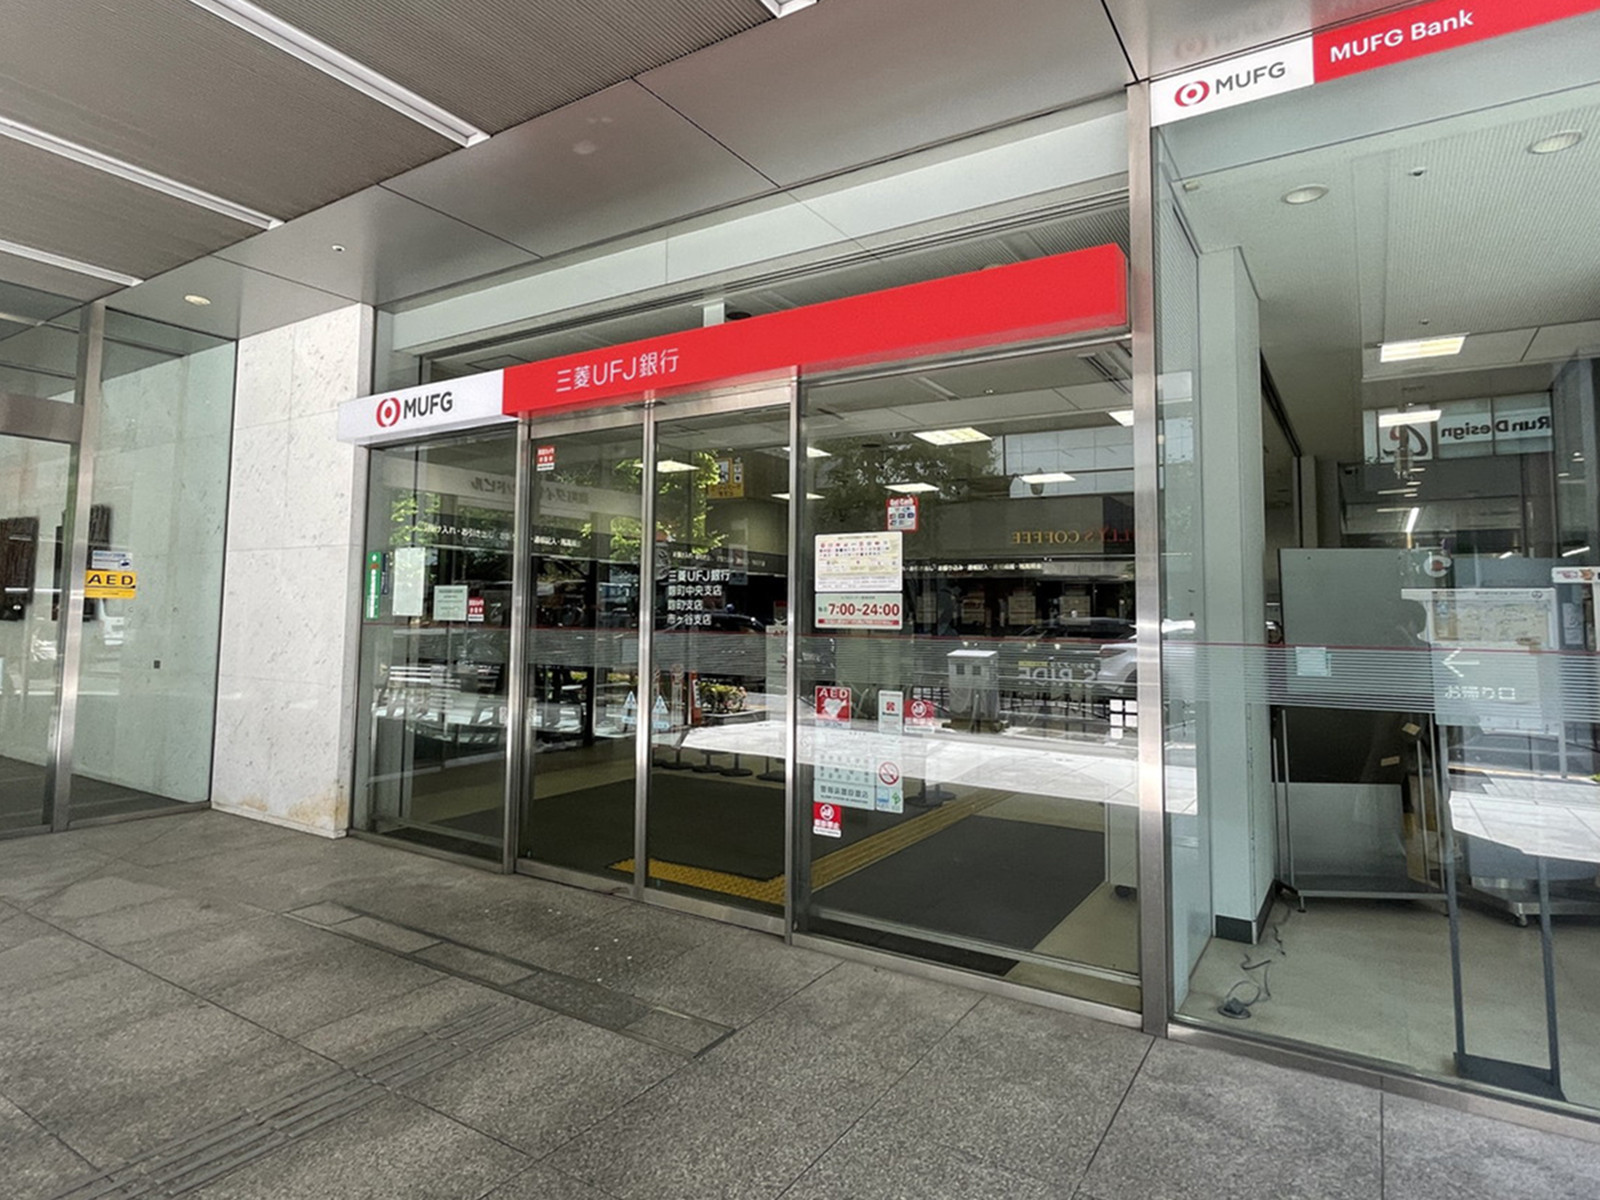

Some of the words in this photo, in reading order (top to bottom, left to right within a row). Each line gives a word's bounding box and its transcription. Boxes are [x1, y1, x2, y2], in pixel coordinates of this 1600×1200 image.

[1329, 30, 1404, 63] MUFG
[1410, 9, 1474, 41] Bank
[1215, 61, 1286, 95] MUFG
[555, 347, 680, 393] 三菱UFJ銀行
[403, 391, 453, 420] MUFG
[88, 574, 134, 585] AED
[668, 569, 730, 583] 三菱UFJ銀行
[818, 689, 849, 699] AED
